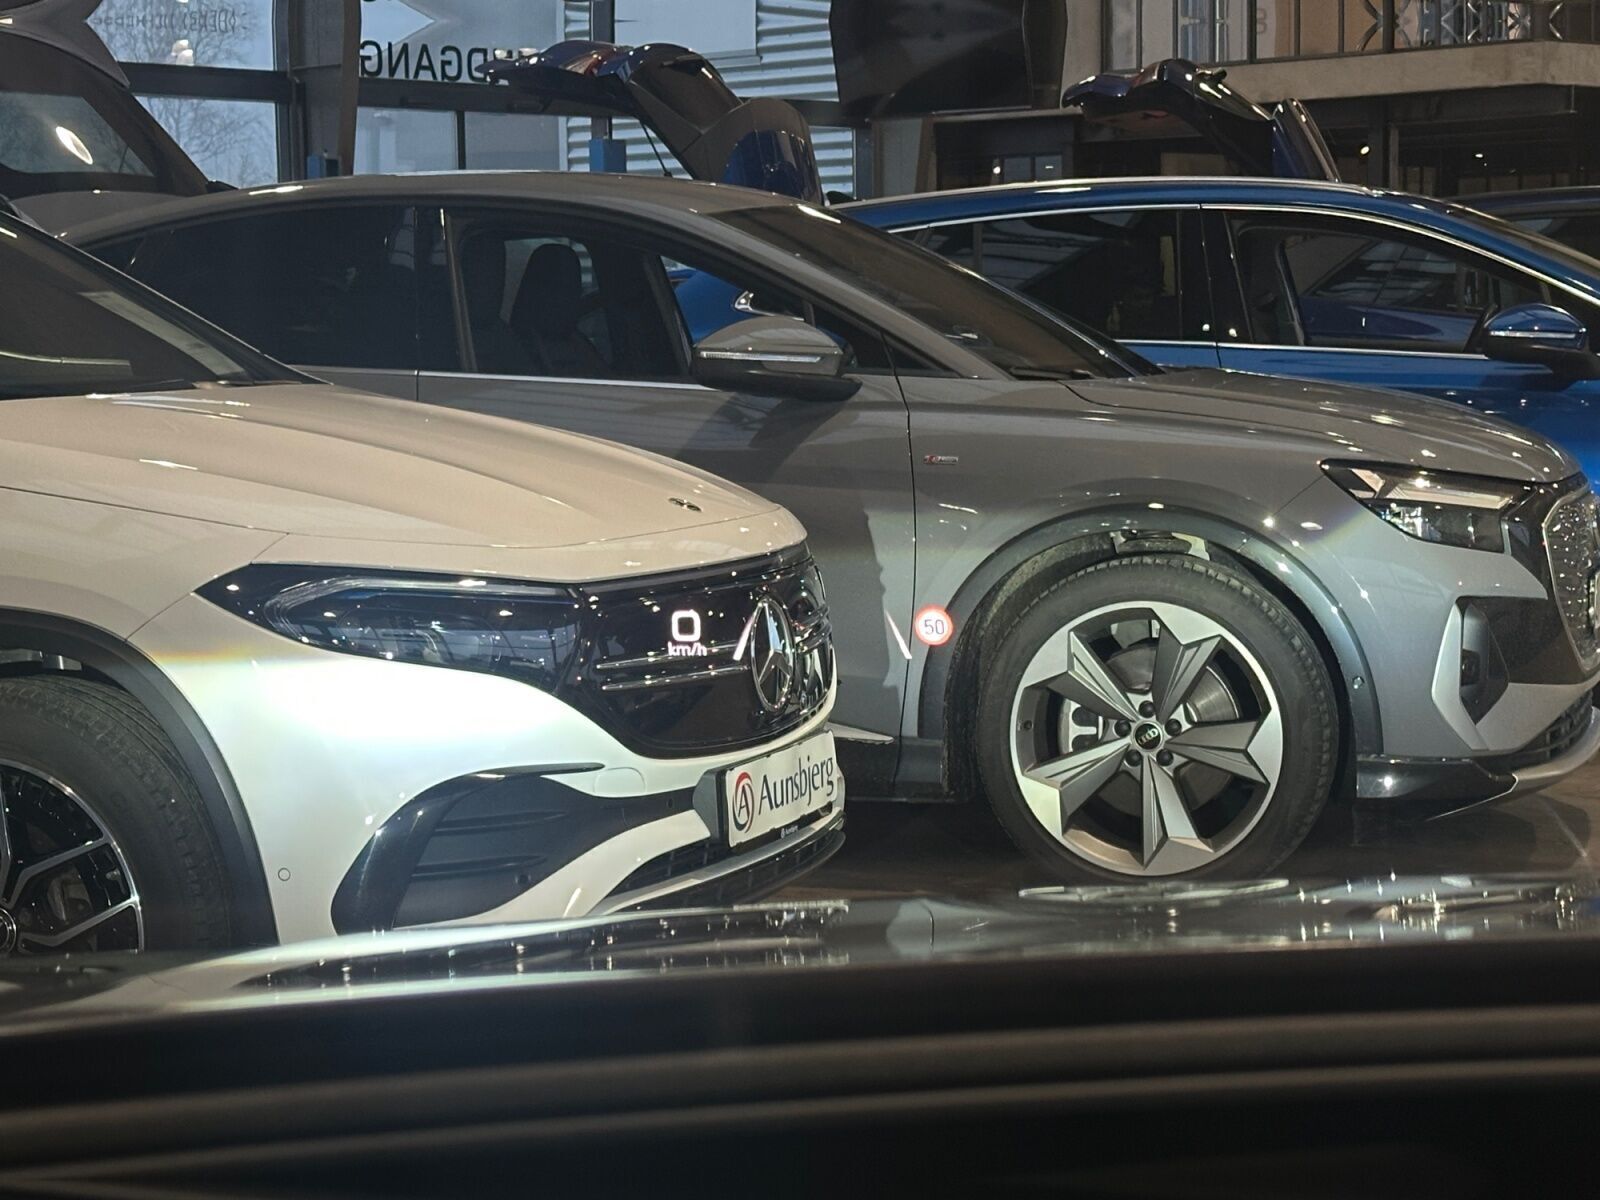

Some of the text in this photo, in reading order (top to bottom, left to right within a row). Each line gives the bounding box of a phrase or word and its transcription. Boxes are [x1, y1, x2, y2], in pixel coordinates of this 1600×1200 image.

[672, 609, 701, 641] 0
[924, 619, 945, 635] 50
[667, 641, 708, 656] km/h
[758, 755, 834, 815] Aunsbjerg
